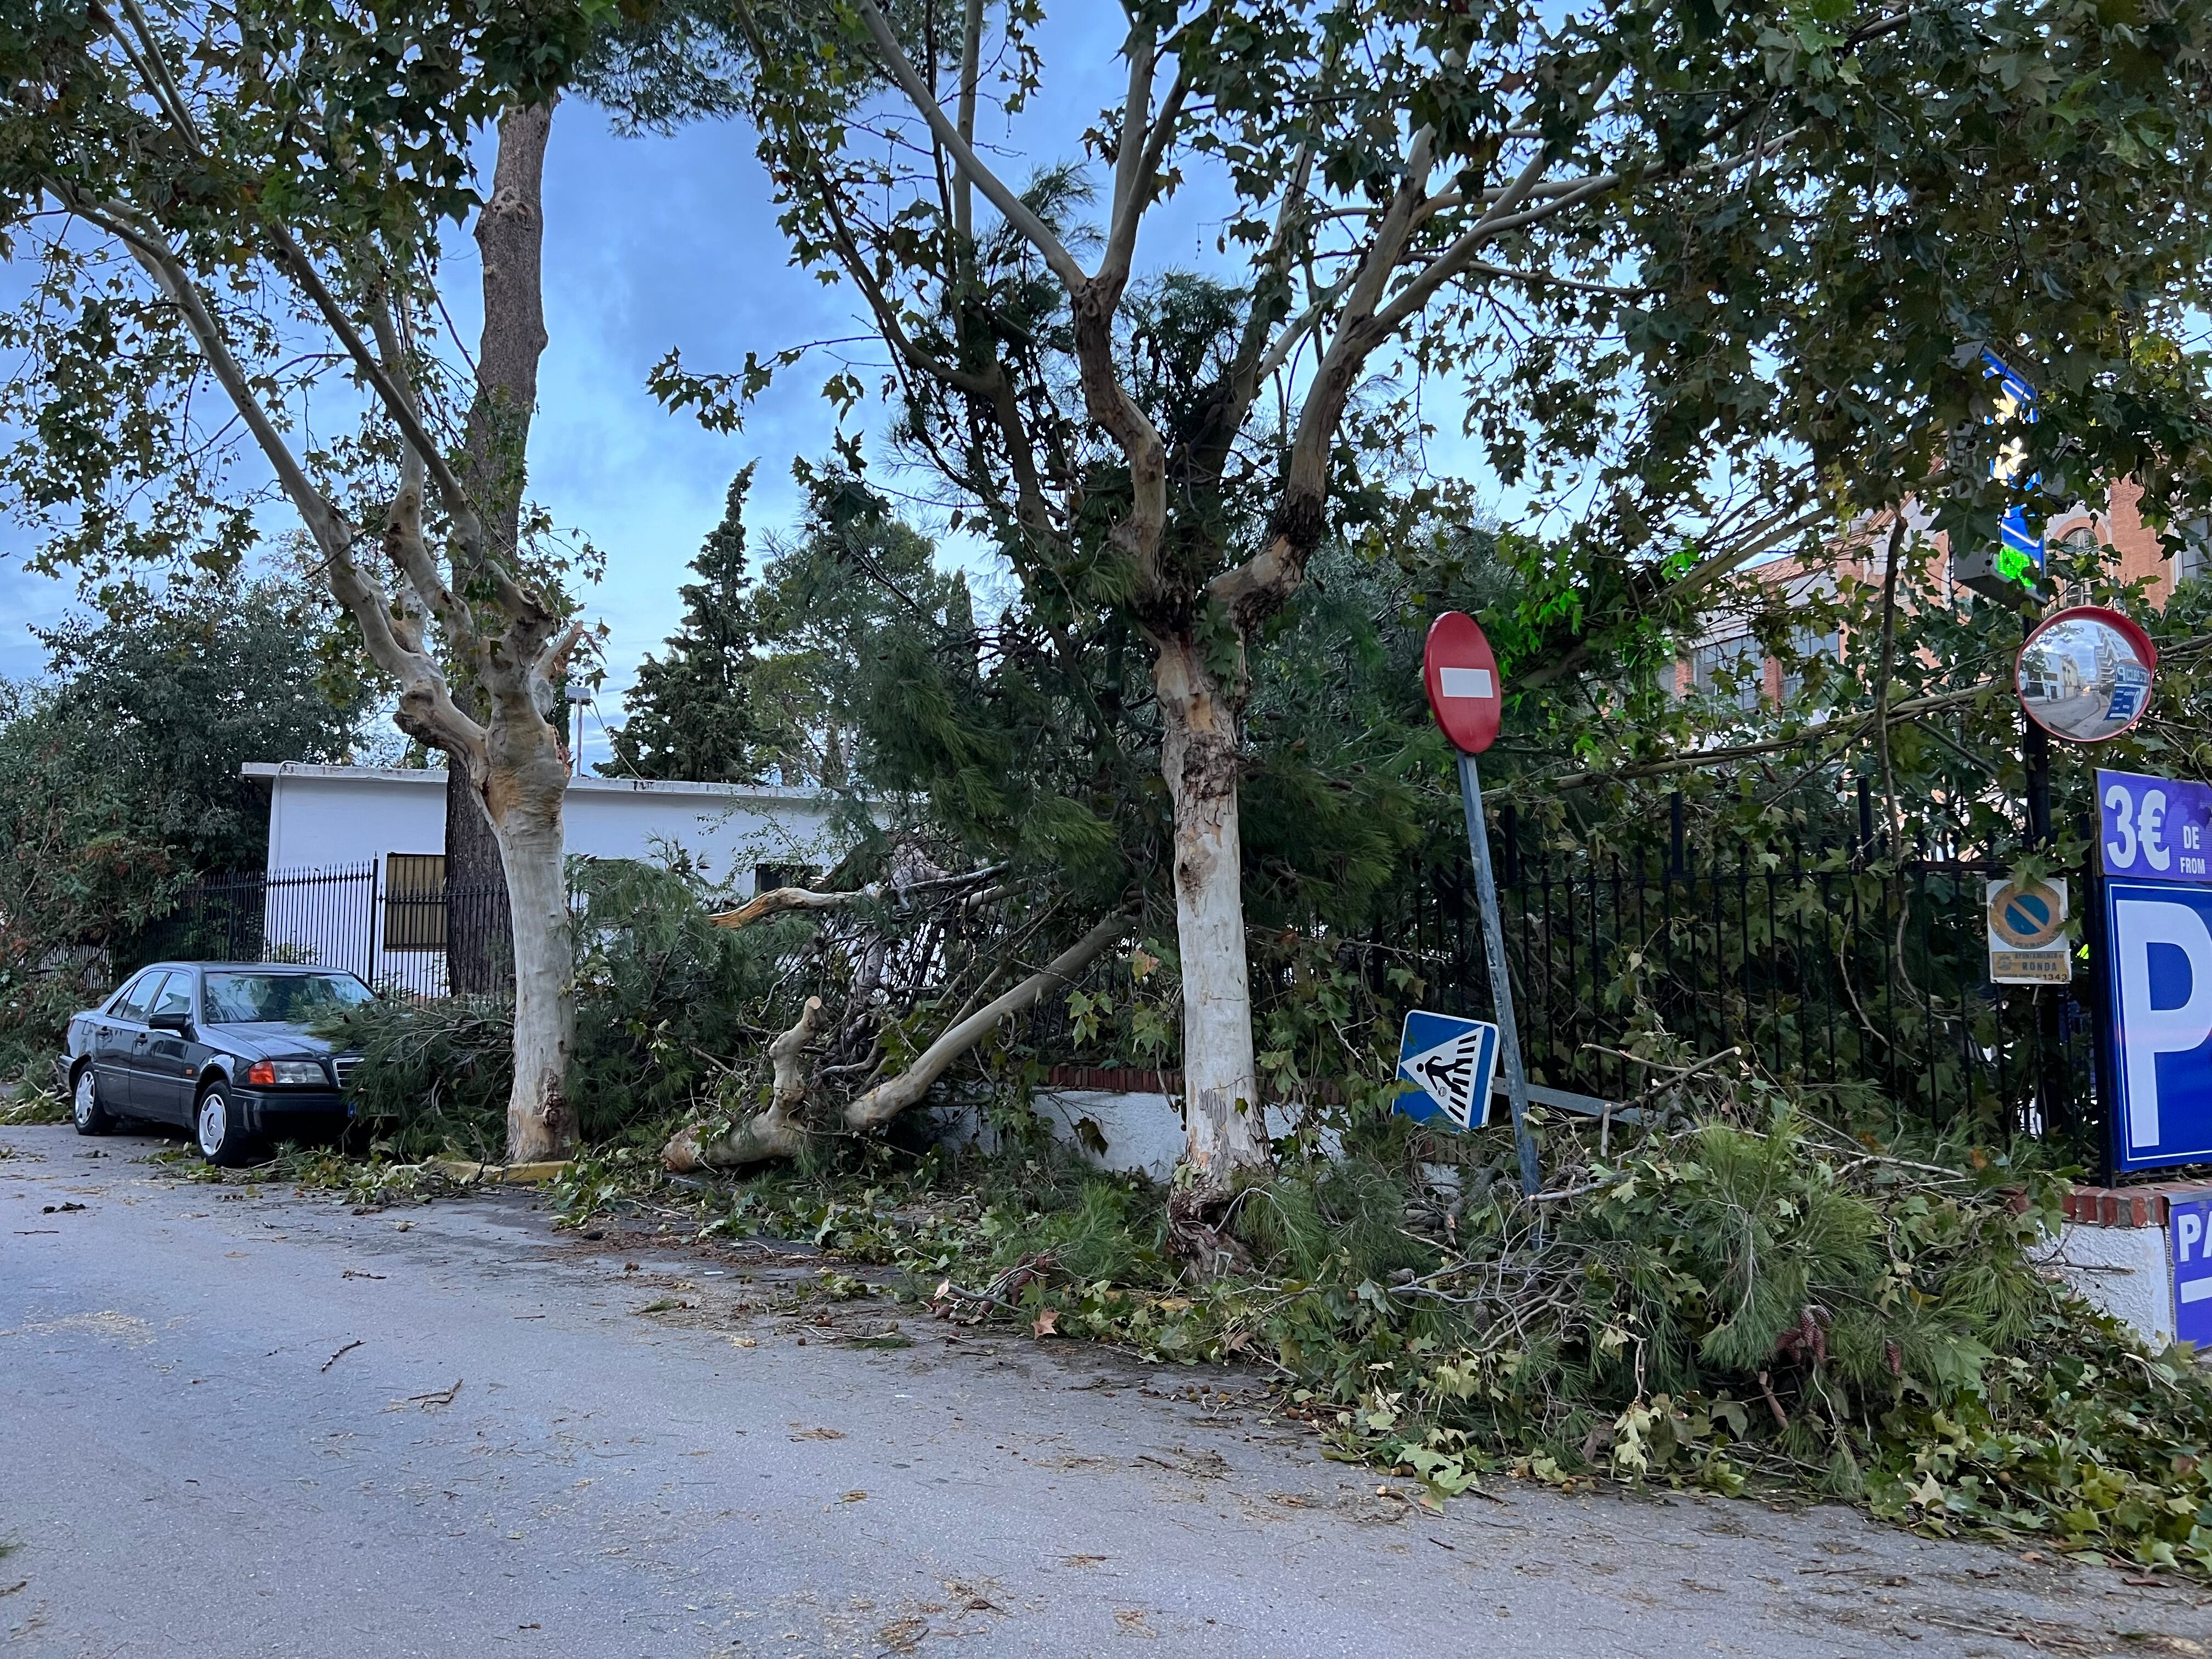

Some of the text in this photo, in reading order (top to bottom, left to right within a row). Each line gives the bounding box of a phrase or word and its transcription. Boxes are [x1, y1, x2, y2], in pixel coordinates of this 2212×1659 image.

[2105, 785, 2170, 871] 3€
[2183, 825, 2200, 850] DE
[2180, 857, 2205, 874] FROM
[2022, 962, 2057, 971] RONDA
[2116, 900, 2212, 1148] P
